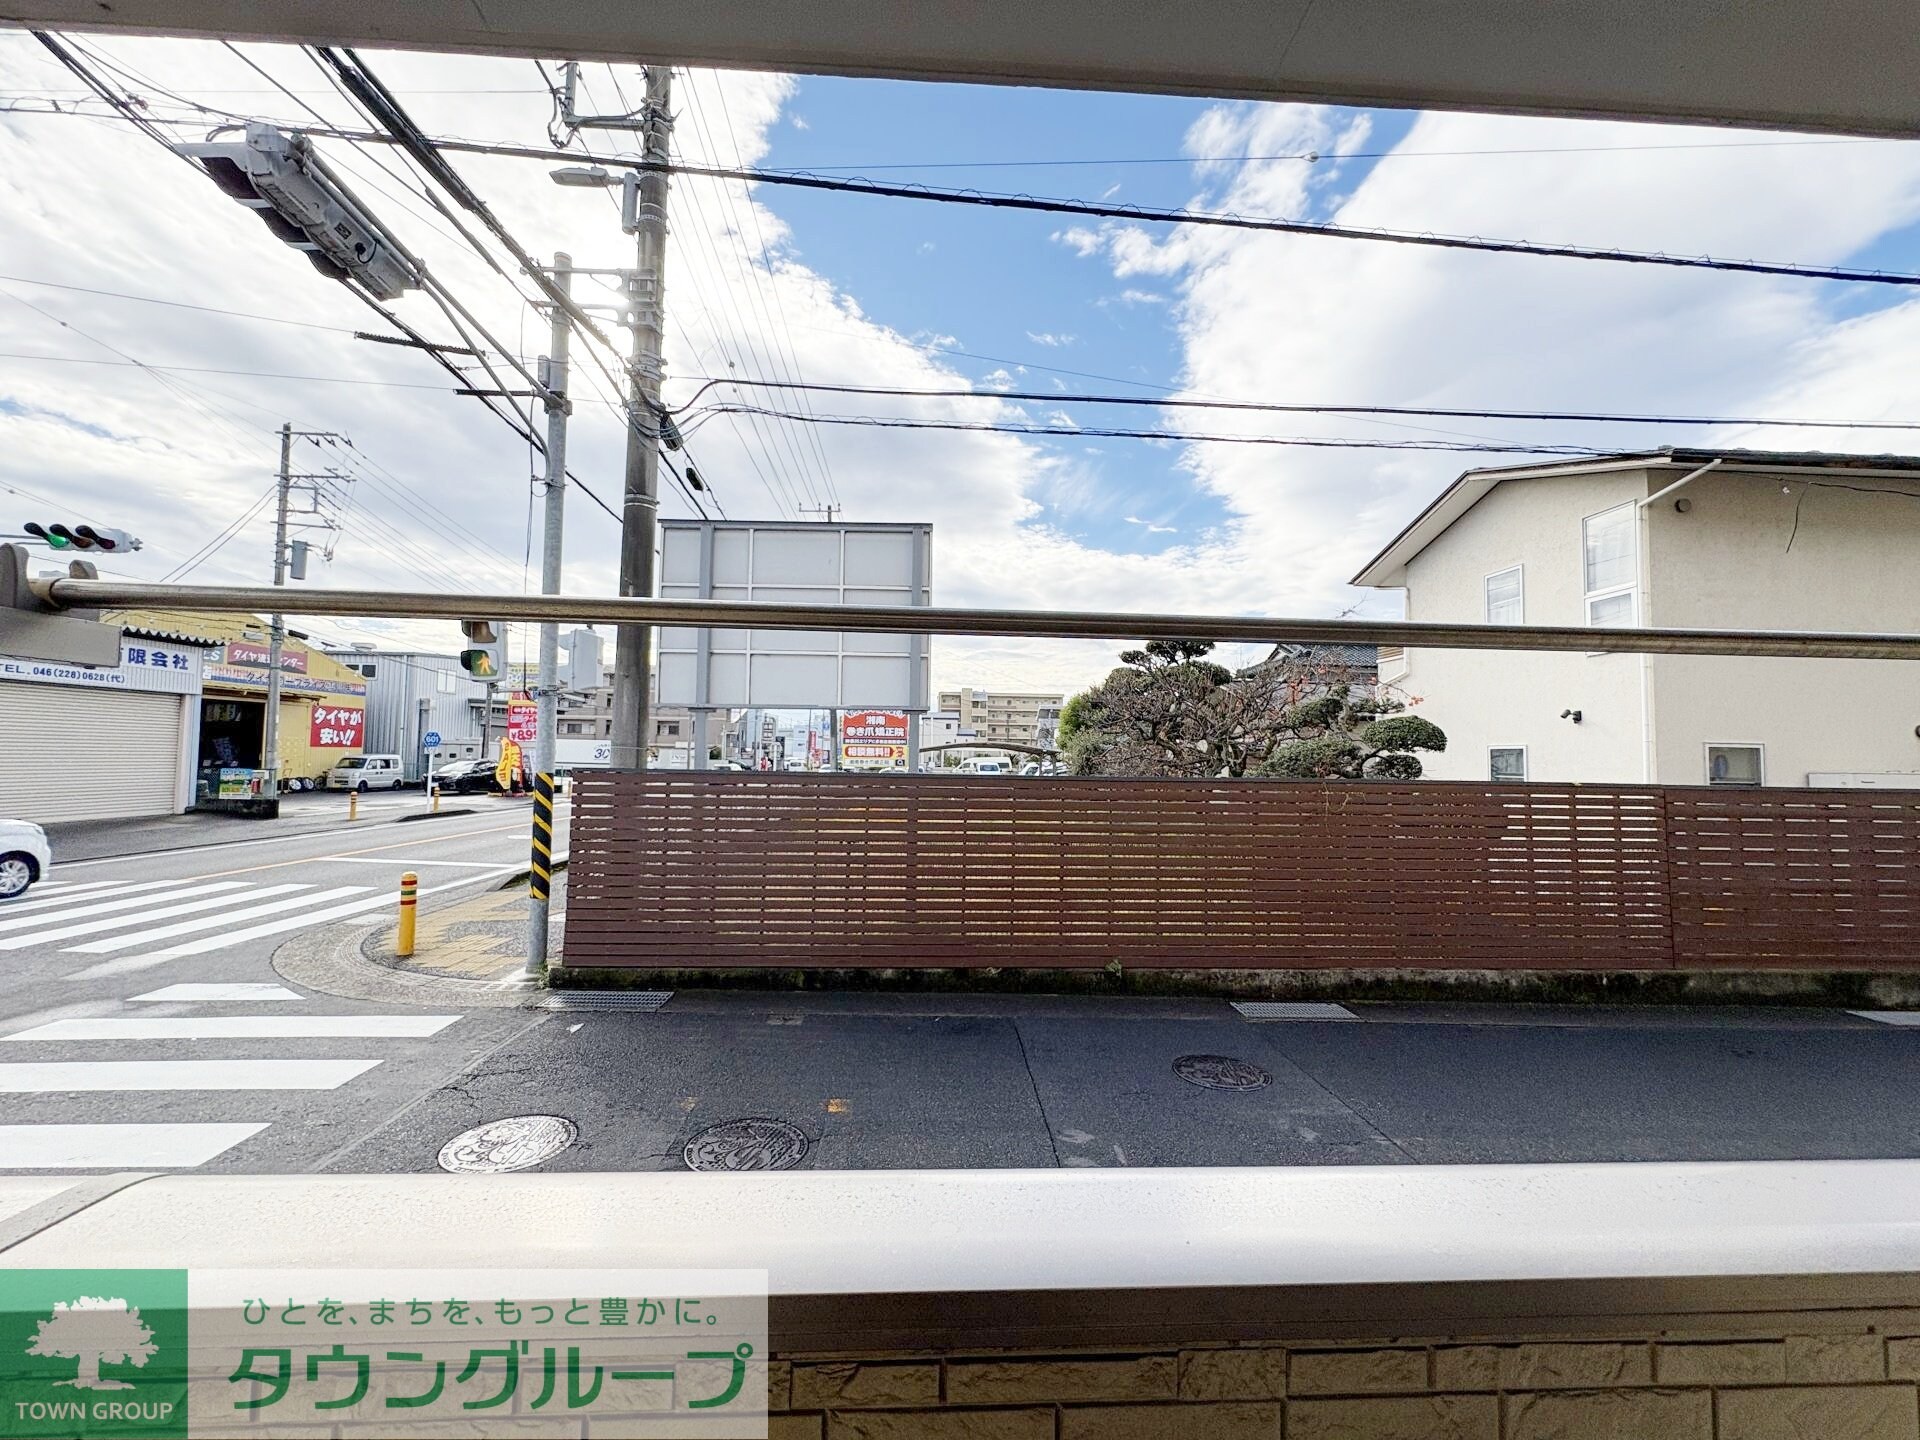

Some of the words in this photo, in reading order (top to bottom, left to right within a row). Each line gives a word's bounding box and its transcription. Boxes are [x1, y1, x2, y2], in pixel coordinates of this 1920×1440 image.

[128, 648, 189, 671] 限会社
[314, 708, 362, 726] タイヤが
